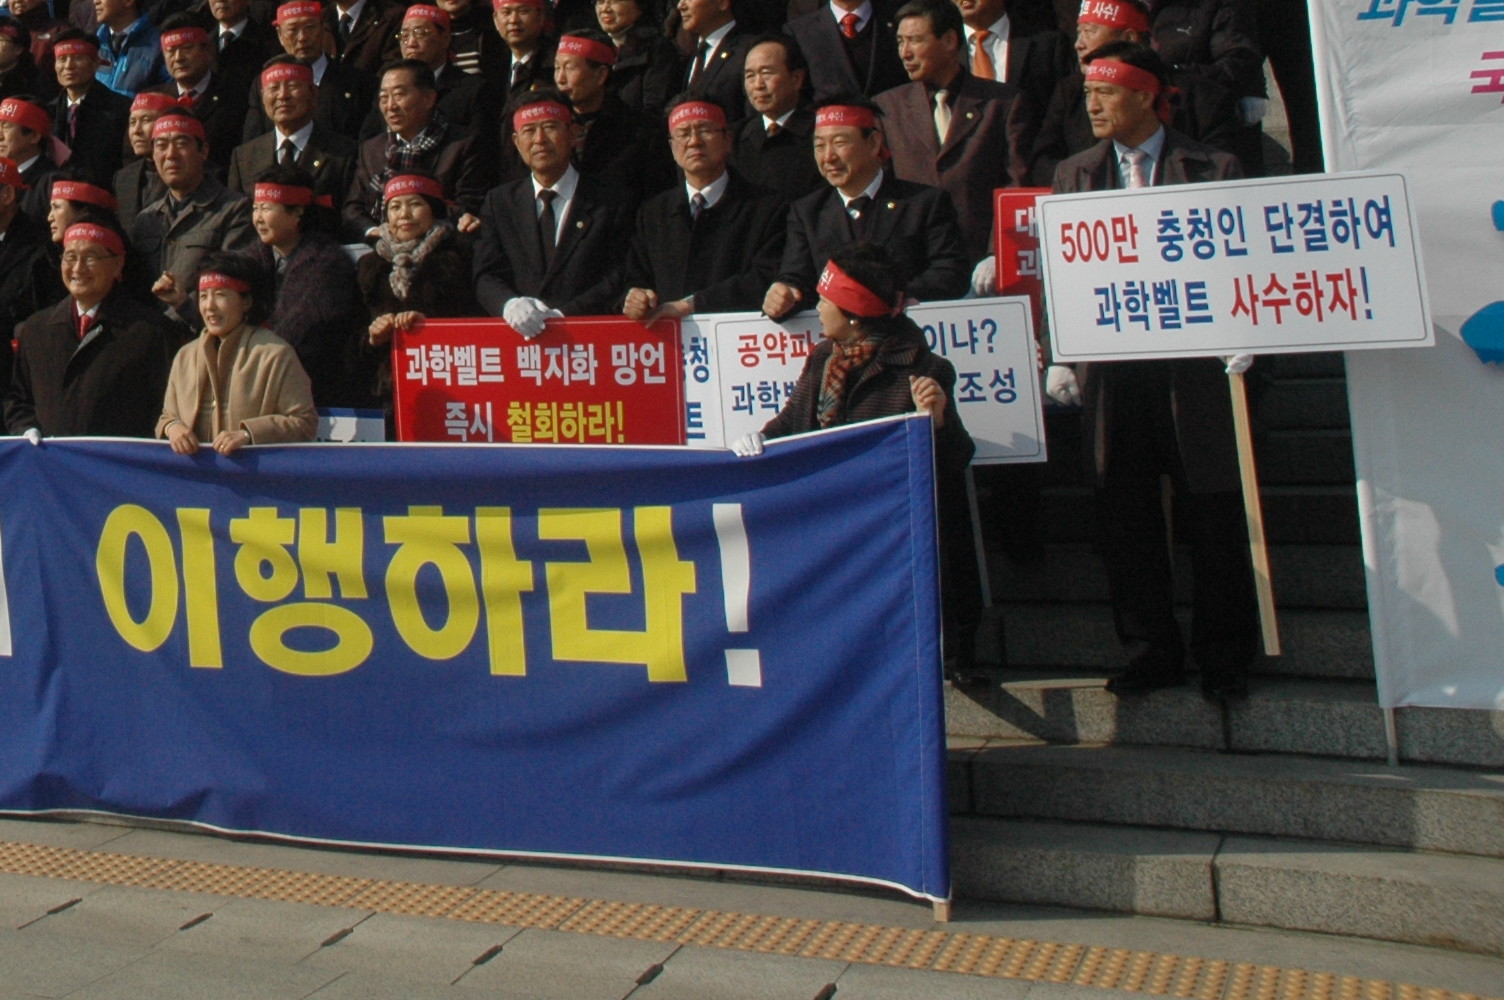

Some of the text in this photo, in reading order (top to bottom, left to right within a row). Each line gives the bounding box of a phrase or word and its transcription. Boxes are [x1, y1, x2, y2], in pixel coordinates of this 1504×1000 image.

[1060, 213, 1139, 264] 500만
[1156, 204, 1249, 263] 충청인
[1263, 194, 1396, 255] 단결하여
[1094, 266, 1374, 333] 과학벨트 사수하자!
[405, 341, 667, 387] 과학벨트 백지화 망언
[959, 367, 1018, 405] 조성
[444, 400, 625, 444] 즉시 철회하라!
[95, 503, 762, 687] 이행하라!
